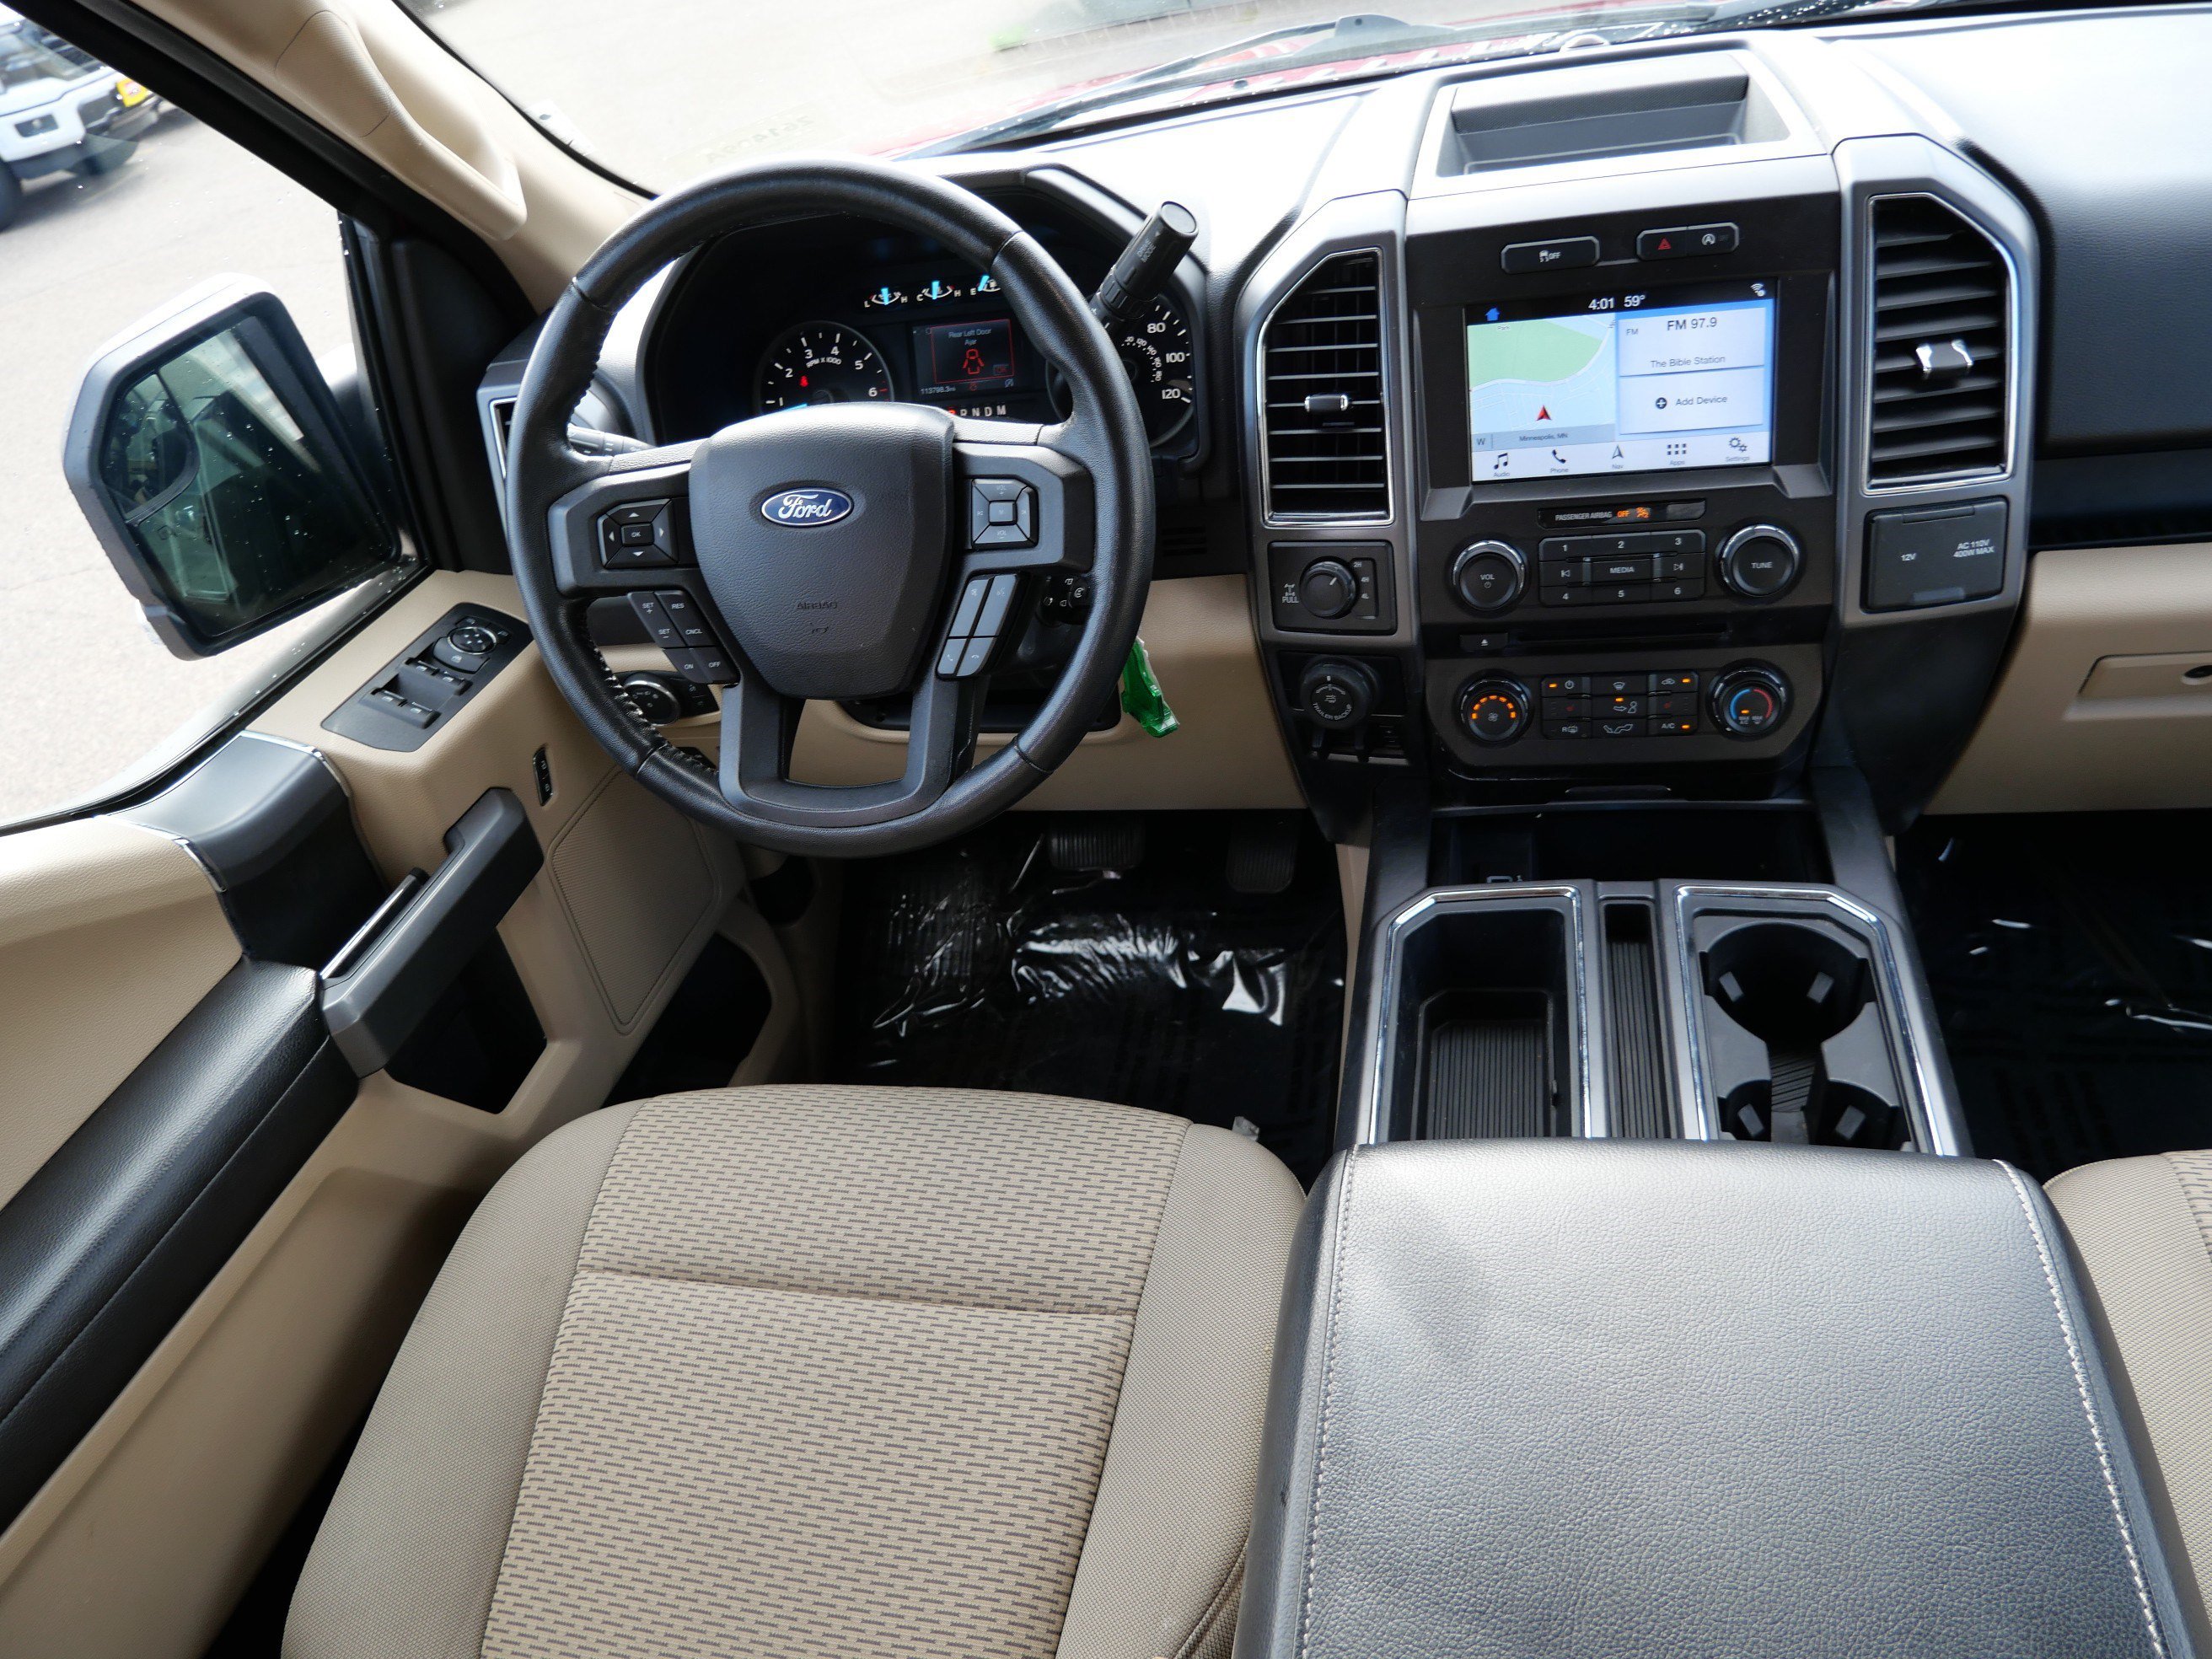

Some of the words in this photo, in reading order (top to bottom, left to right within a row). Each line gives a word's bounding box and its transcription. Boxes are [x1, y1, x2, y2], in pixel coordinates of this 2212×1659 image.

[970, 287, 976, 296] E
[916, 293, 923, 302] C
[1588, 298, 1615, 310] 4:01
[1147, 322, 1167, 334] 80
[1667, 319, 1687, 330] FM
[1690, 317, 1717, 330] 97.9
[804, 349, 813, 359] 3
[830, 346, 840, 356] 4
[1165, 352, 1185, 363] 100
[1651, 359, 1667, 368] The
[1669, 358, 1691, 368] Bible
[1694, 356, 1726, 365] Station
[854, 360, 863, 370] 5
[785, 368, 793, 378] 2
[868, 387, 878, 397] 6
[1162, 388, 1181, 400] 120
[1675, 398, 1694, 406] Add
[1696, 395, 1728, 405] Device
[971, 407, 980, 416] N
[984, 406, 992, 416] D
[996, 405, 1007, 416] M
[1477, 438, 1486, 446] W
[778, 494, 832, 519] Ford
[1555, 512, 1590, 521] PASSENGER
[1590, 510, 1612, 518] AIRBAG
[1617, 509, 1630, 518] OFF
[1618, 540, 1625, 549] 2
[1674, 537, 1682, 545] 3
[1970, 539, 1990, 548] 110V
[1562, 544, 1568, 552] 1
[1953, 549, 1975, 558] 400W
[1975, 545, 1995, 555] MAX
[1900, 553, 1917, 561] 12V
[1609, 566, 1635, 574] MEDIA
